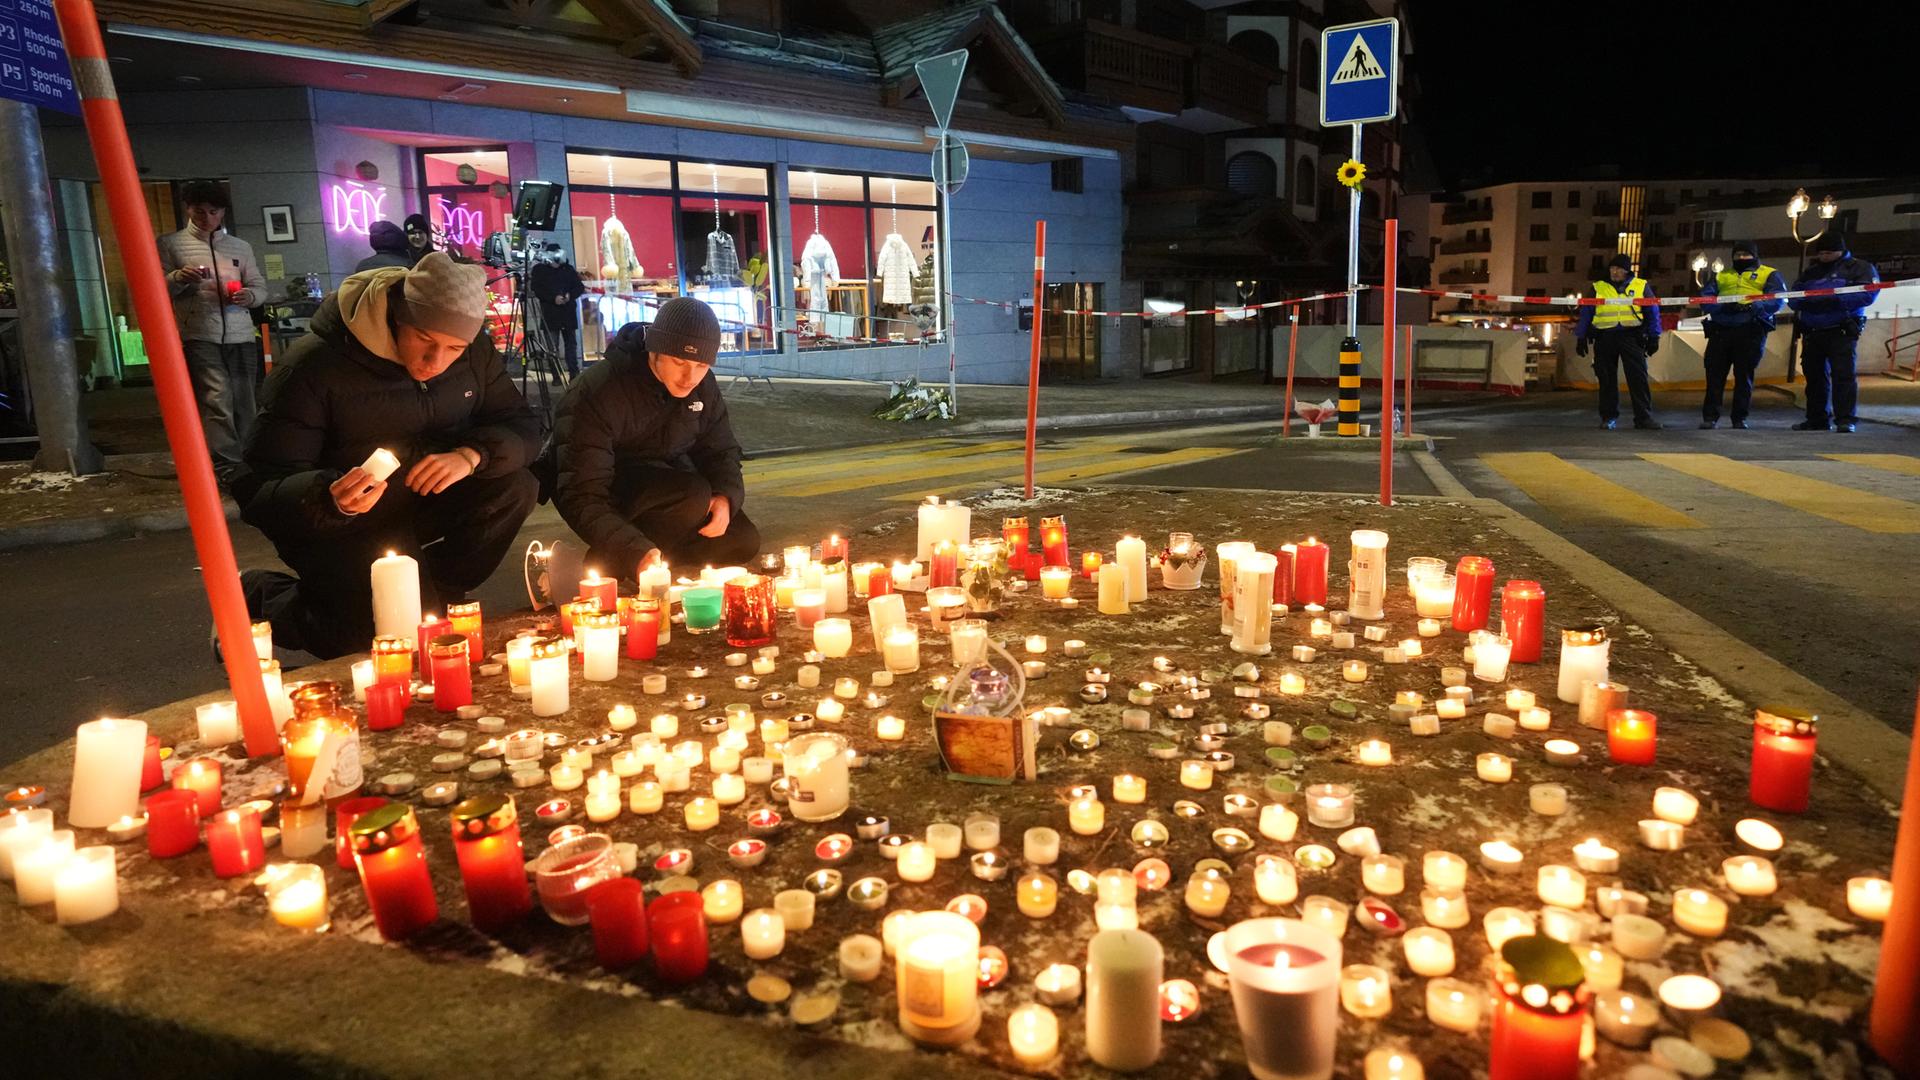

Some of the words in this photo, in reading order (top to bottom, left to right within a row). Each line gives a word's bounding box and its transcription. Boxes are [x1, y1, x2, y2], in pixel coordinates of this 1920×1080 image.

[20, 1, 39, 16] 250
[40, 10, 51, 20] m
[26, 41, 46, 56] 500
[47, 50, 57, 60] m
[3, 63, 22, 80] P5
[30, 66, 72, 90] Sporting
[33, 81, 51, 95] 500
[53, 88, 62, 98] m
